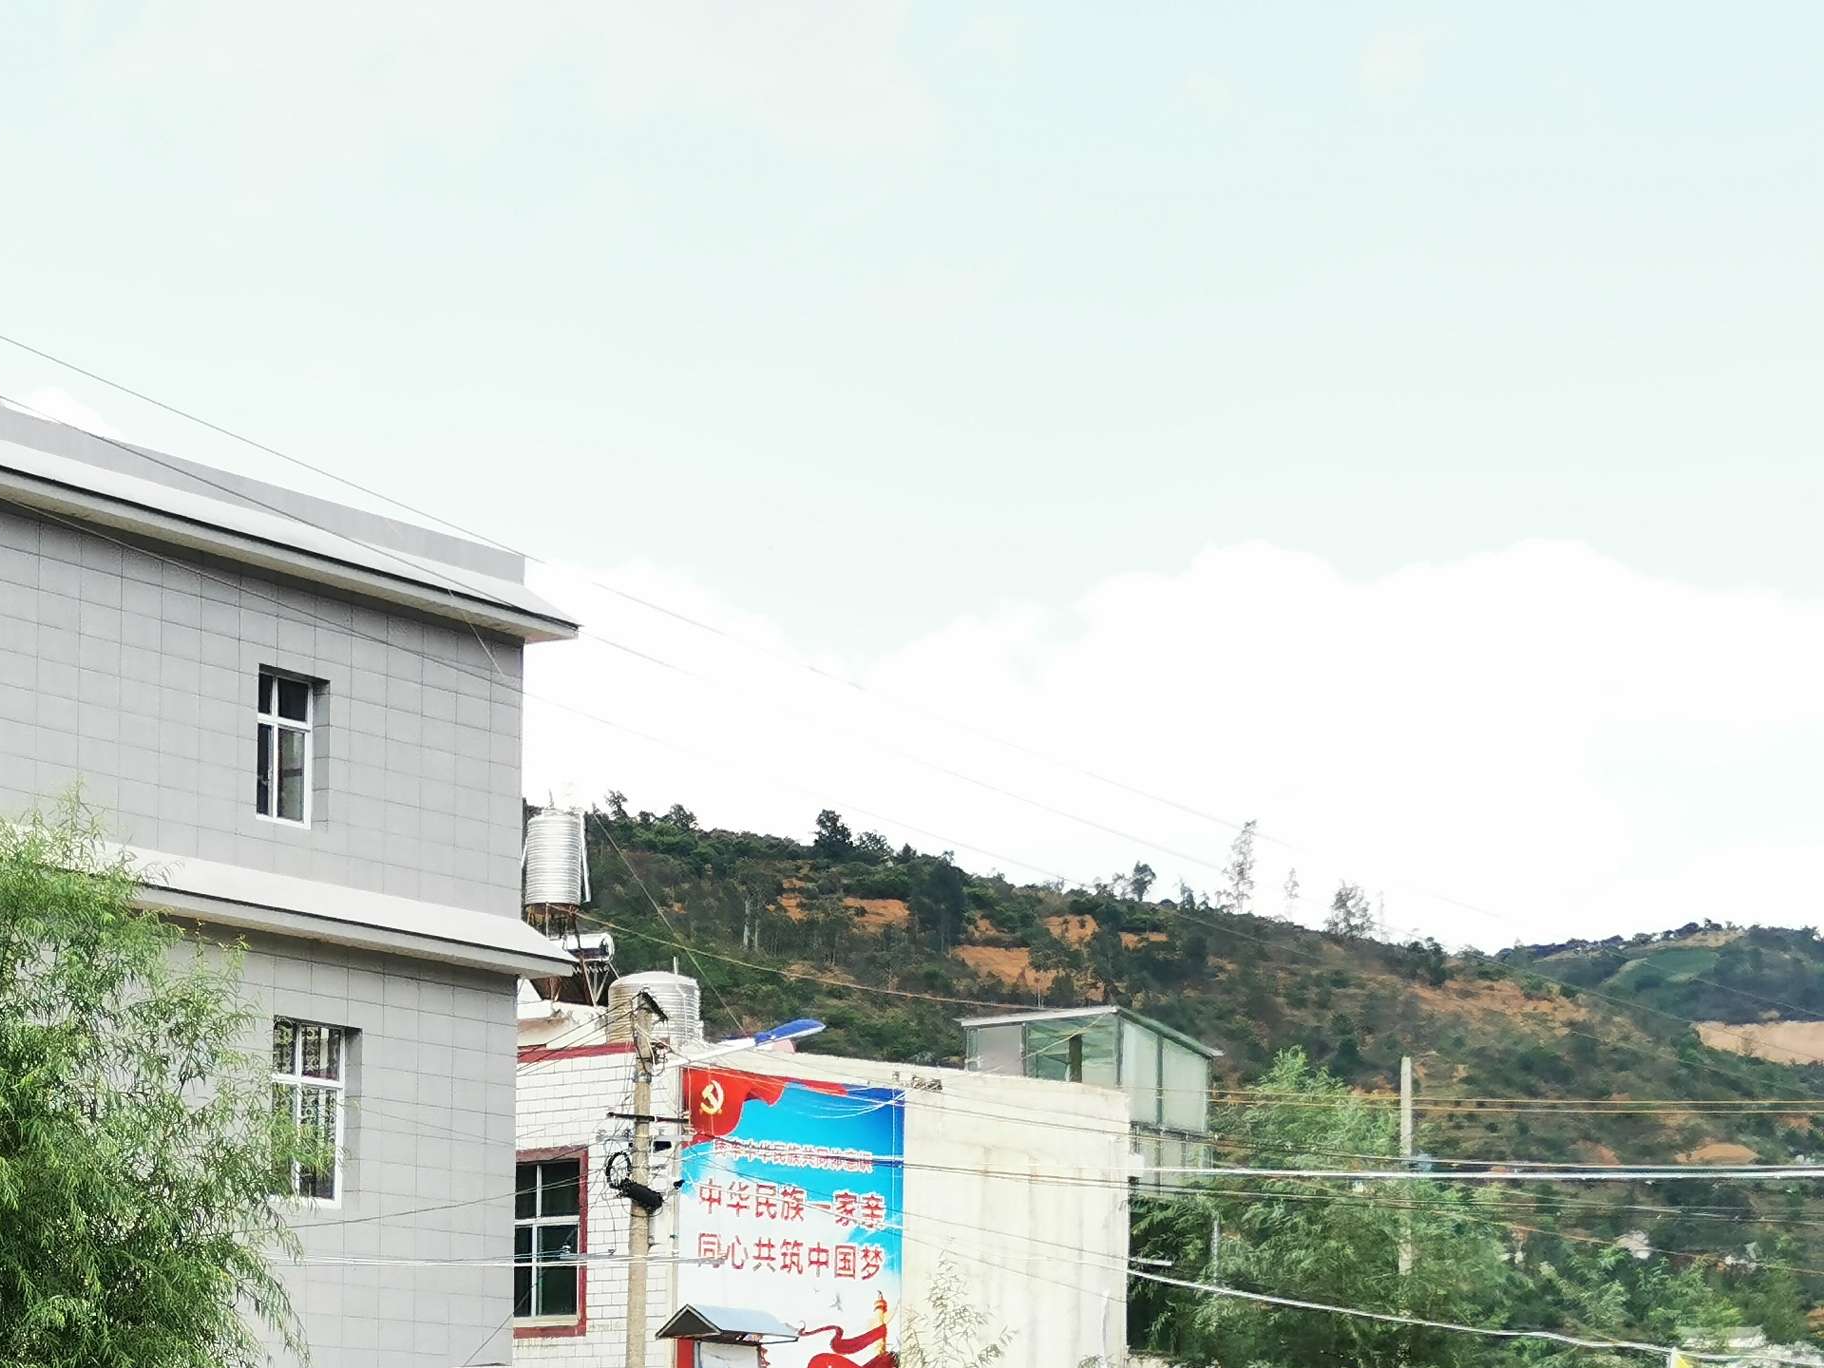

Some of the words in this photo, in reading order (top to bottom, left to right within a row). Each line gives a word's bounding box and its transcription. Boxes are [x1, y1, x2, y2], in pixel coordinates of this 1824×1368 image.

[699, 1178, 886, 1229] 中华民族一家亲
[698, 1232, 885, 1281] 同心共筑中国梦
